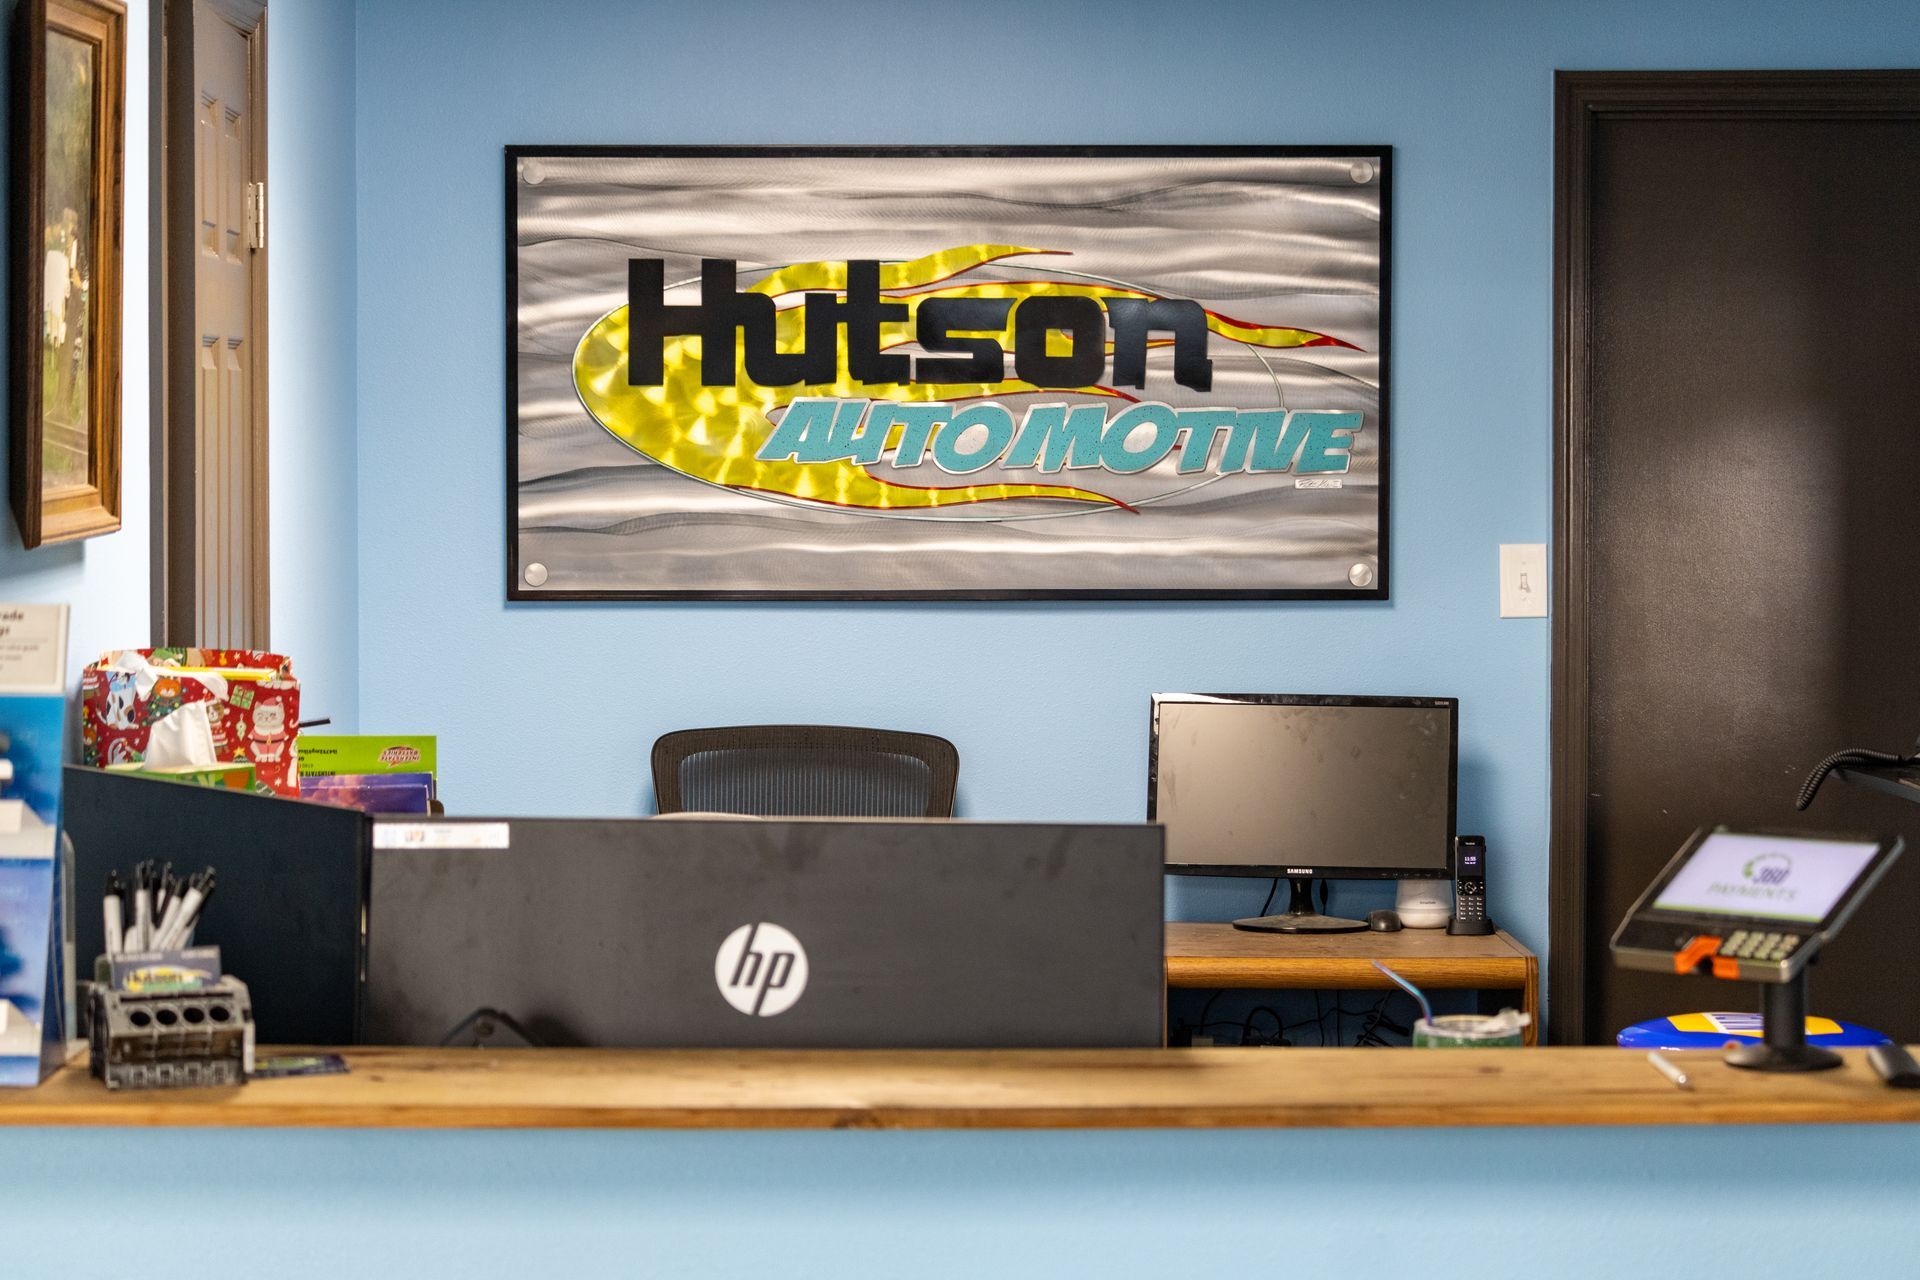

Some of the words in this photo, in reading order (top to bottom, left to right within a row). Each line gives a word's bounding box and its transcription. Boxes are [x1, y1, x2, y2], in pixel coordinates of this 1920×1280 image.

[628, 259, 1212, 392] Hutson
[754, 397, 1364, 475] AUTOMOTIVE
[729, 921, 796, 1016] hp
